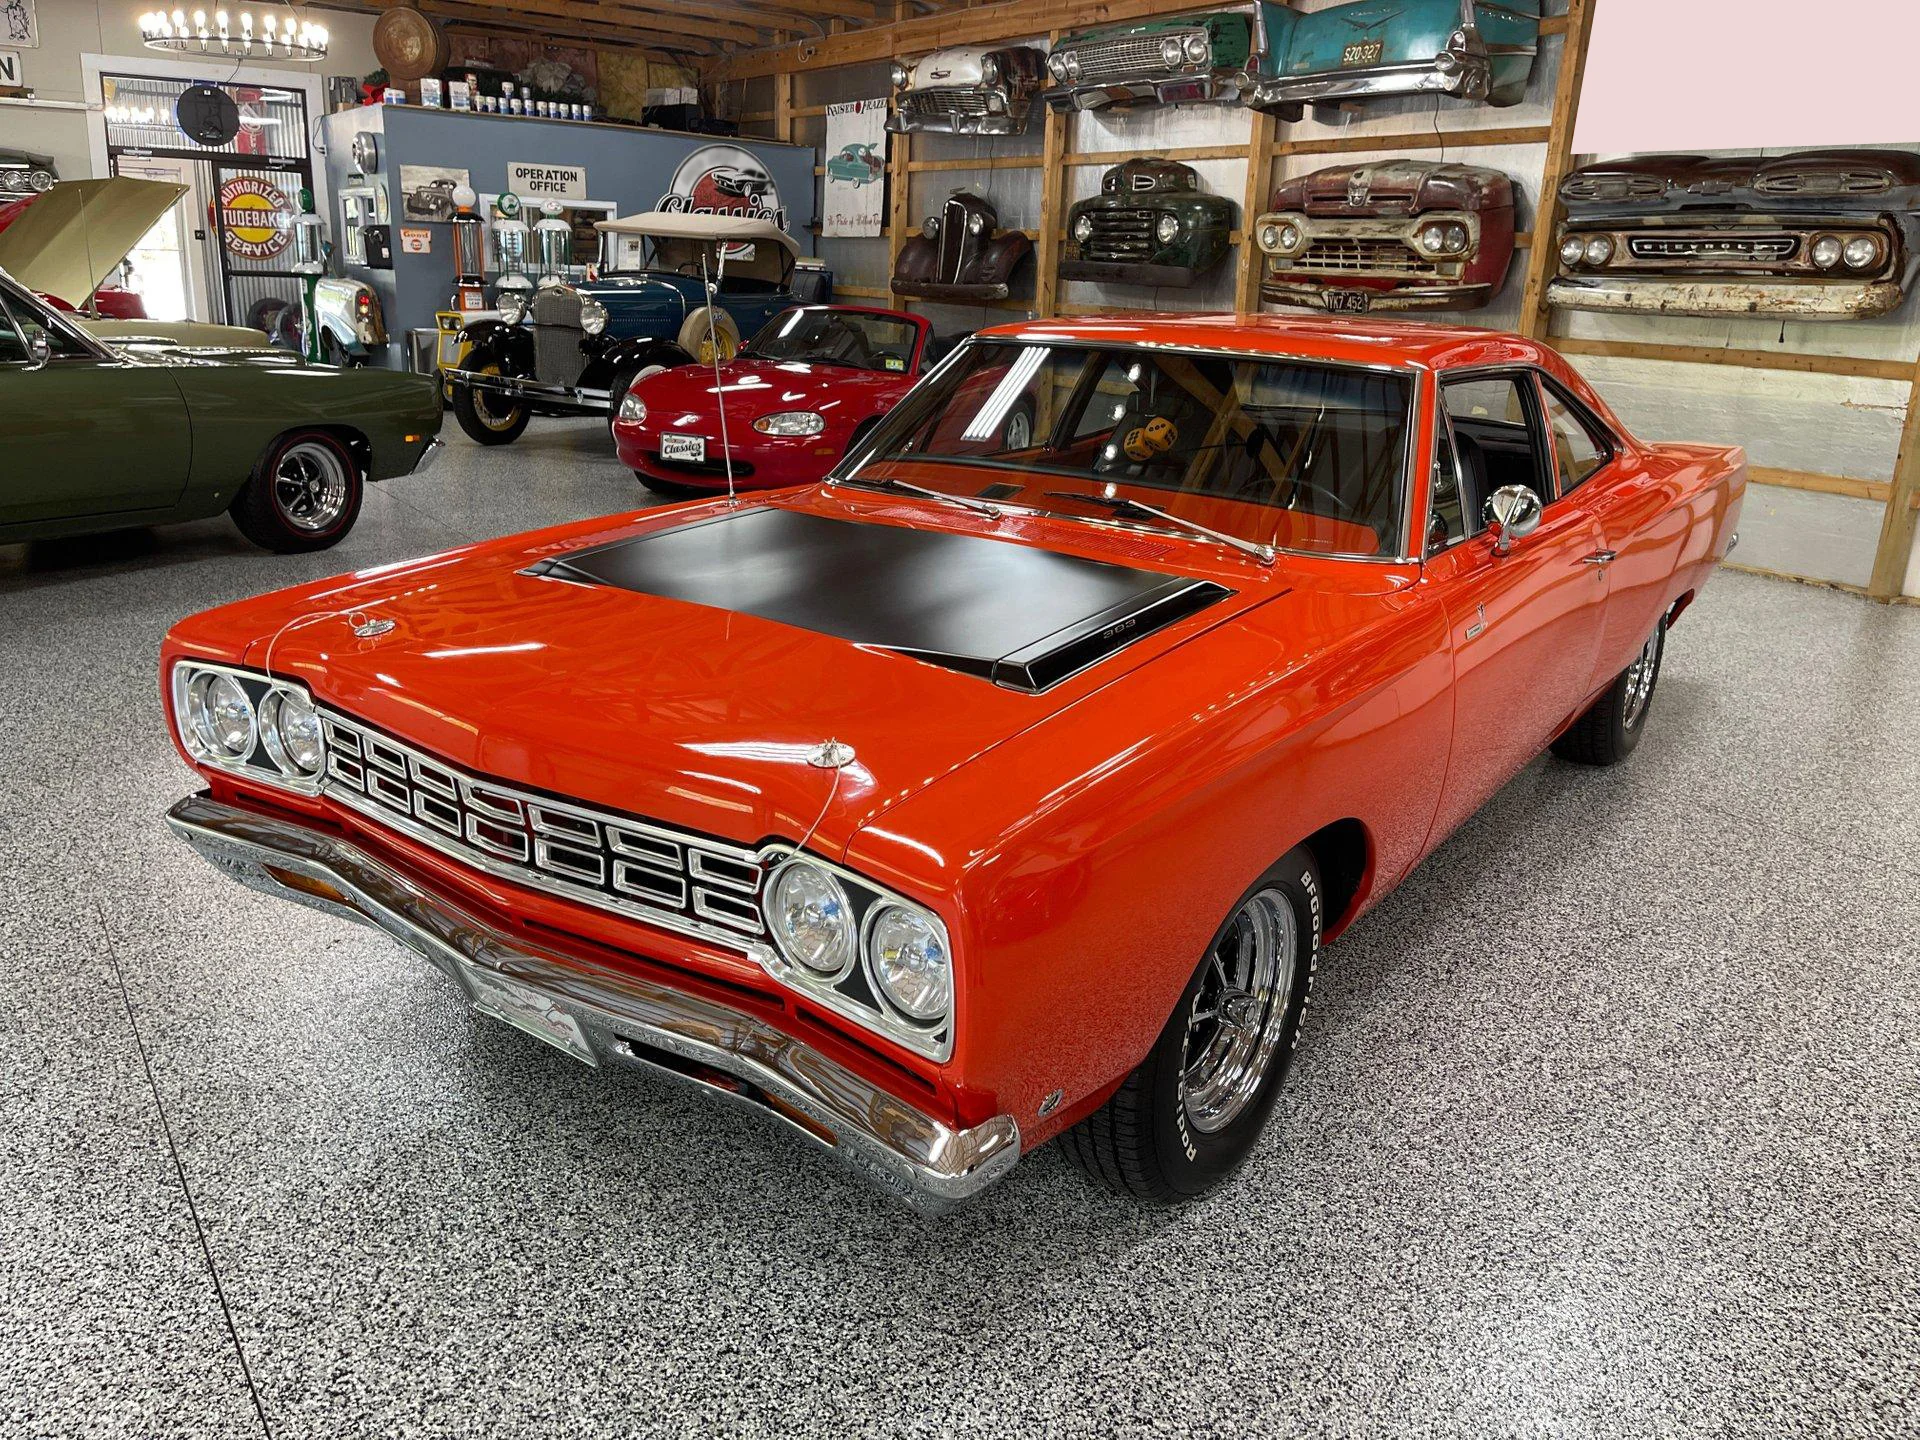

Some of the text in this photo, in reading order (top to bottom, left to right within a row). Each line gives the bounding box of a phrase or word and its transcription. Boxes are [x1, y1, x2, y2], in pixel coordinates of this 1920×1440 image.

[515, 167, 578, 182] OPERATION
[221, 180, 284, 207] AUTHORIZED
[529, 180, 567, 193] OFFICE
[222, 208, 291, 229] TUDEBAKER
[225, 230, 288, 256] SERVICE
[1346, 295, 1363, 310] 452
[664, 440, 702, 455] Classics
